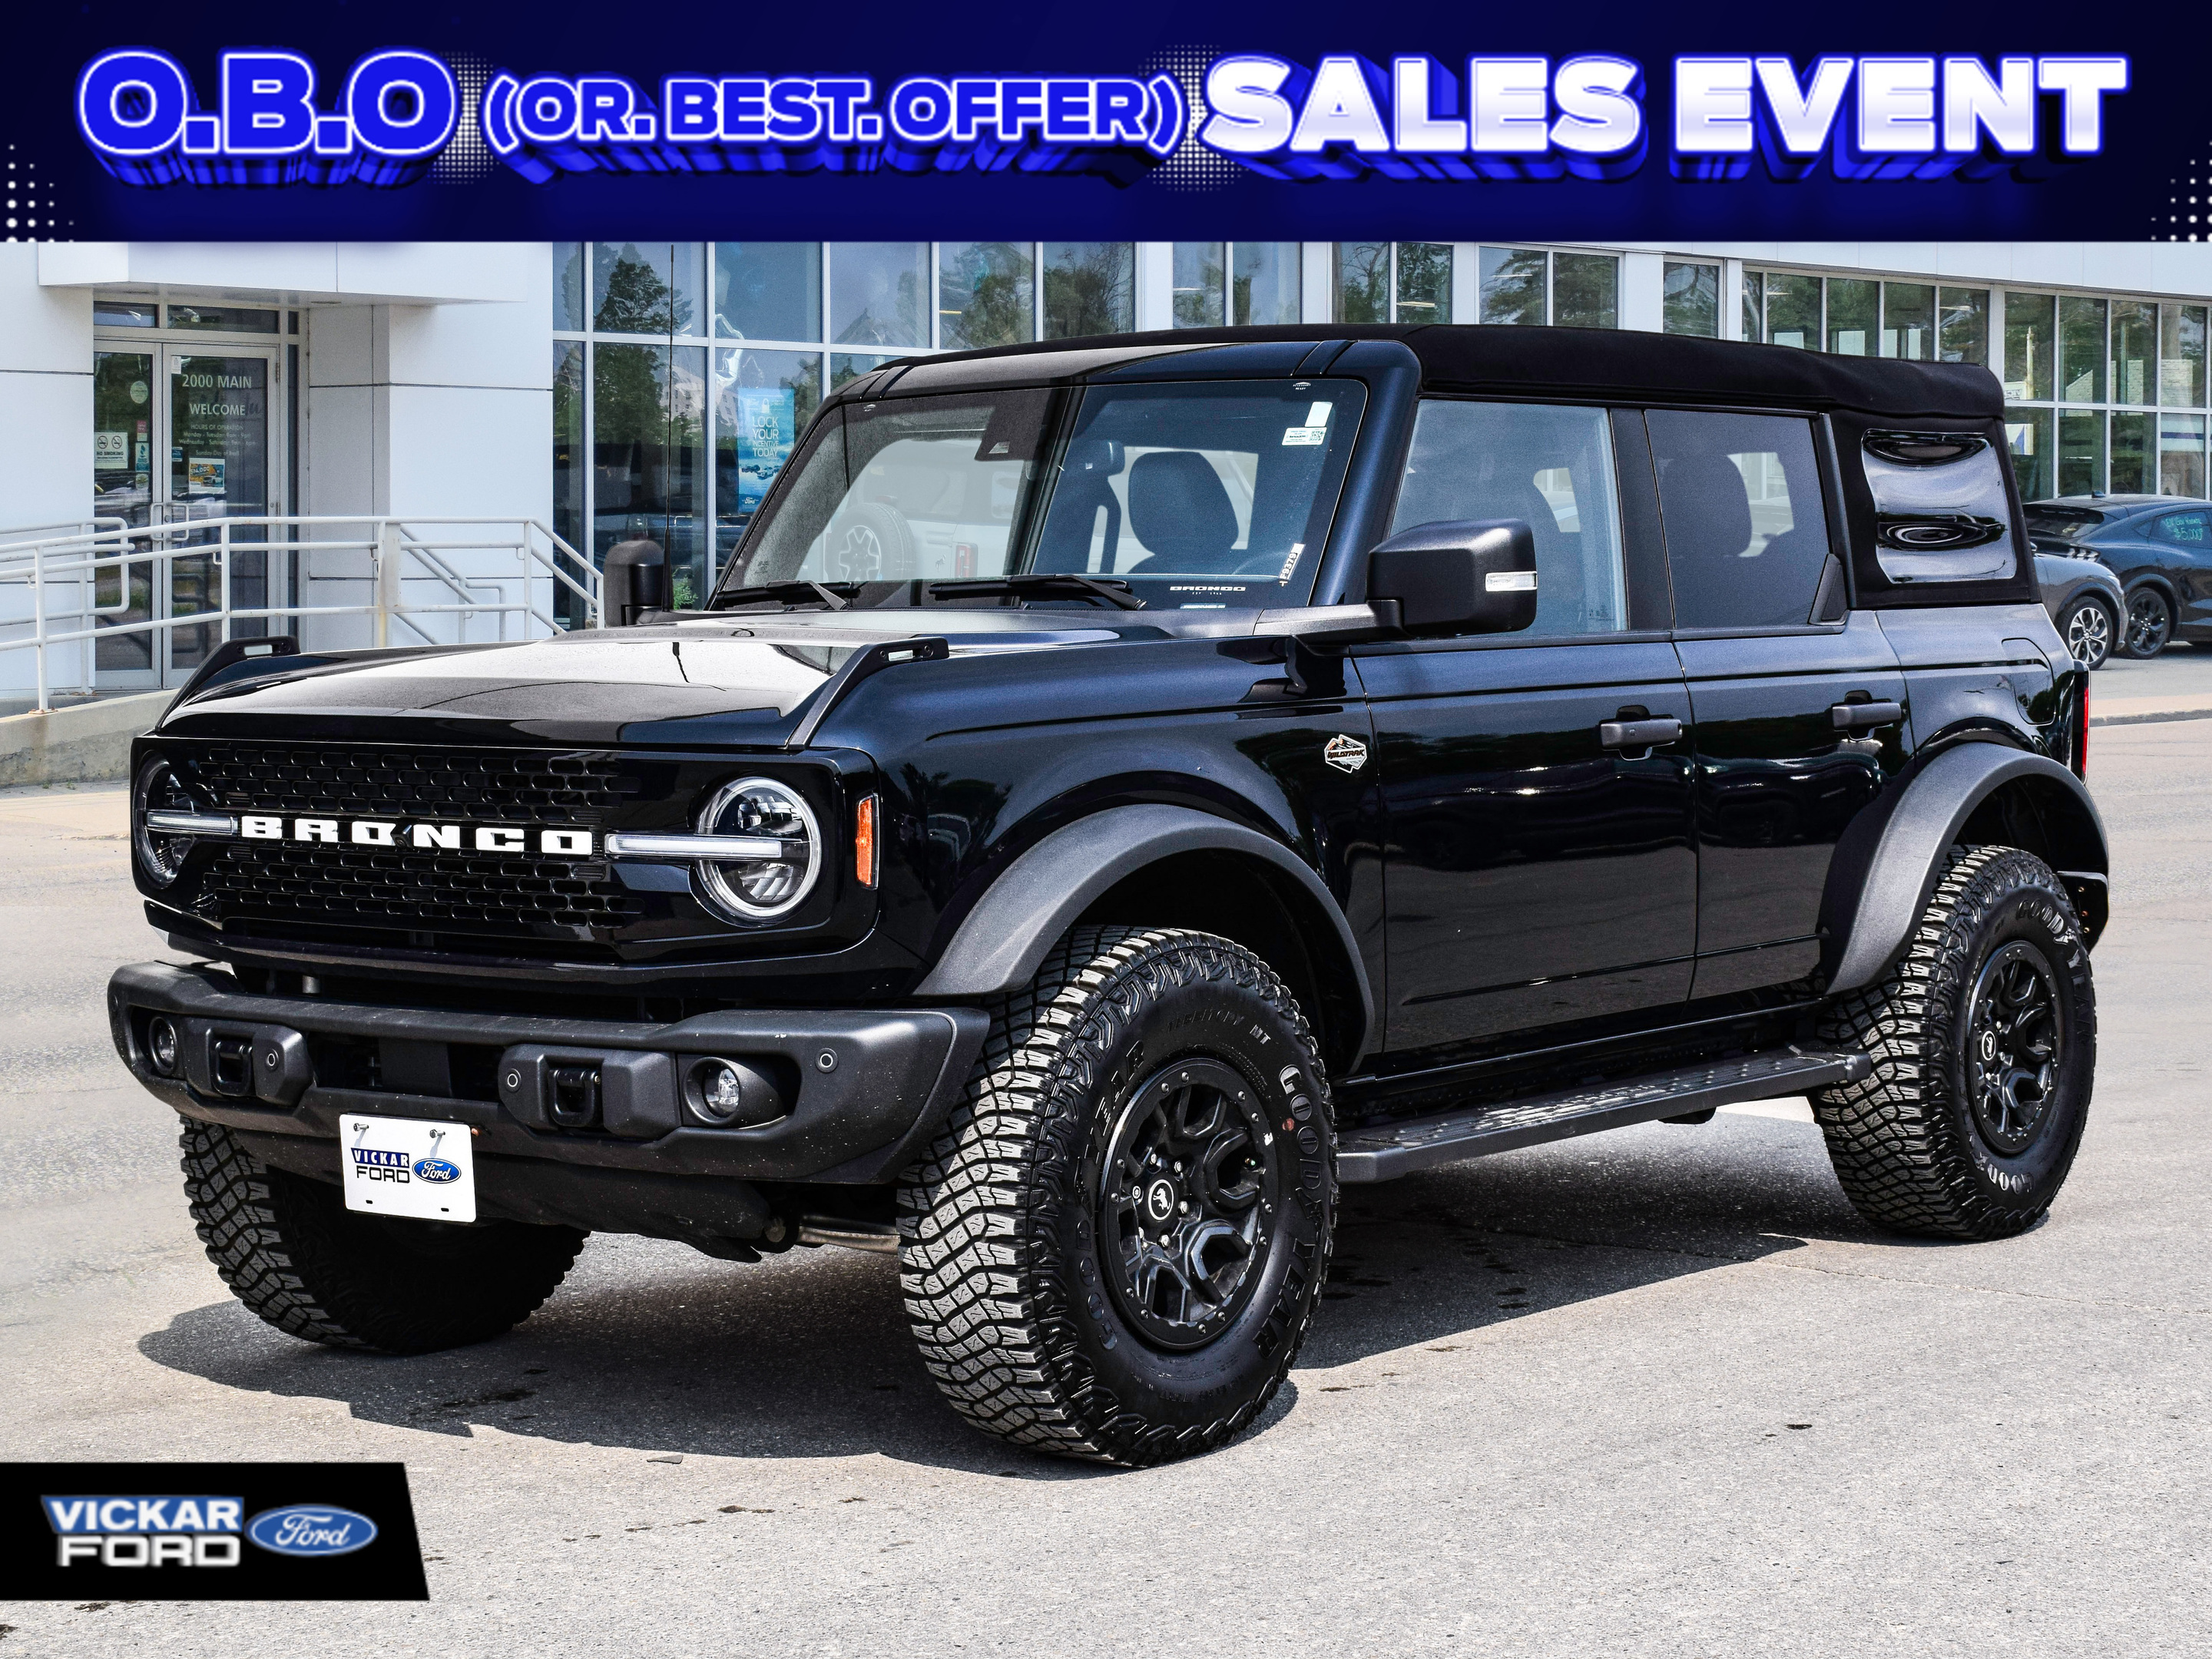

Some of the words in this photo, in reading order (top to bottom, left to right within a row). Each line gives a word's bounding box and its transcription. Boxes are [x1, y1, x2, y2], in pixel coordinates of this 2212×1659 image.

[181, 374, 214, 388] 2000
[217, 375, 252, 389] MAIN
[189, 403, 246, 416] WELCOME
[752, 416, 779, 428] LOCK
[752, 428, 780, 439] YOUR
[752, 448, 778, 457] TODAY
[1327, 749, 1365, 760] WILDTRAK
[241, 815, 594, 856] BRONCO
[1249, 1024, 1272, 1045] MT
[353, 1149, 409, 1167] VICKAR
[356, 1164, 410, 1184] FORD
[421, 1161, 452, 1181] Ford
